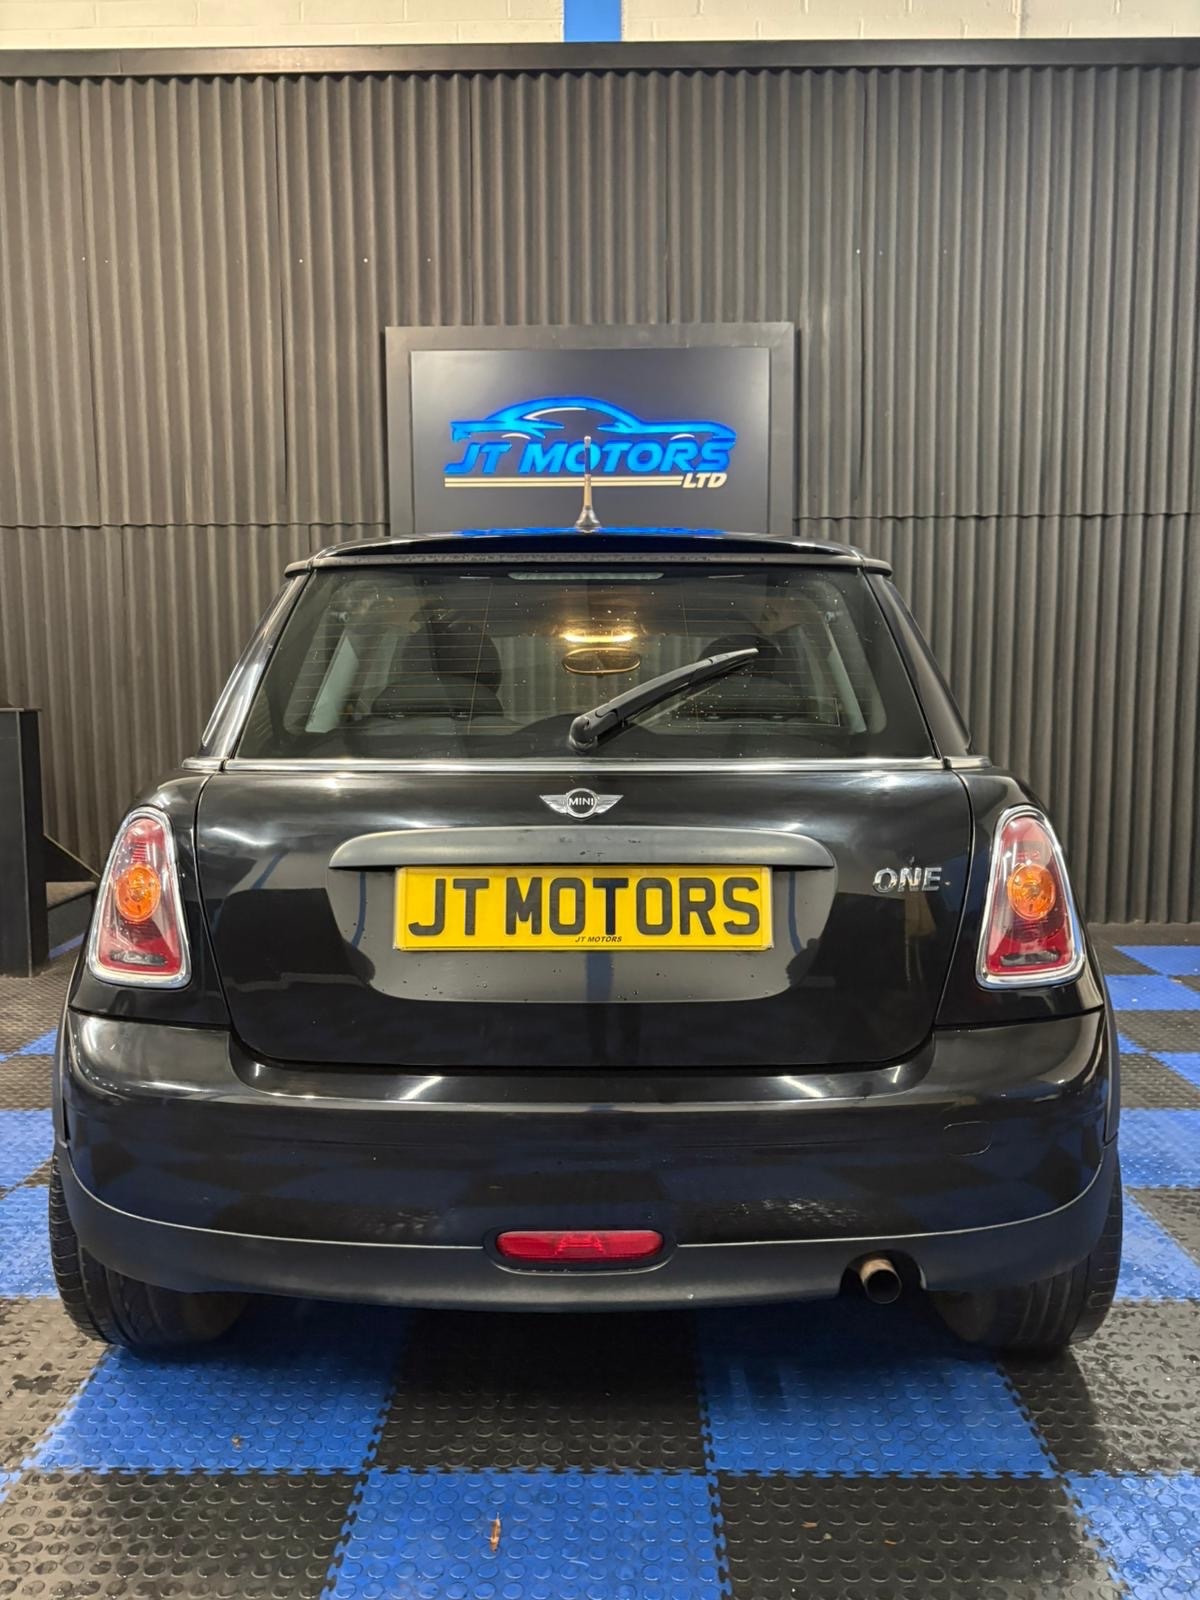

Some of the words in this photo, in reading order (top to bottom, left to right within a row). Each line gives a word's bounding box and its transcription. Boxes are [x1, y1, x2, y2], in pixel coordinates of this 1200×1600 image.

[443, 441, 512, 474] JT
[518, 439, 736, 474] MOTORS
[682, 472, 728, 489] LTD
[569, 797, 594, 806] MINI
[873, 867, 943, 893] ONE
[408, 878, 490, 937] JT
[505, 876, 760, 937] MOTORS
